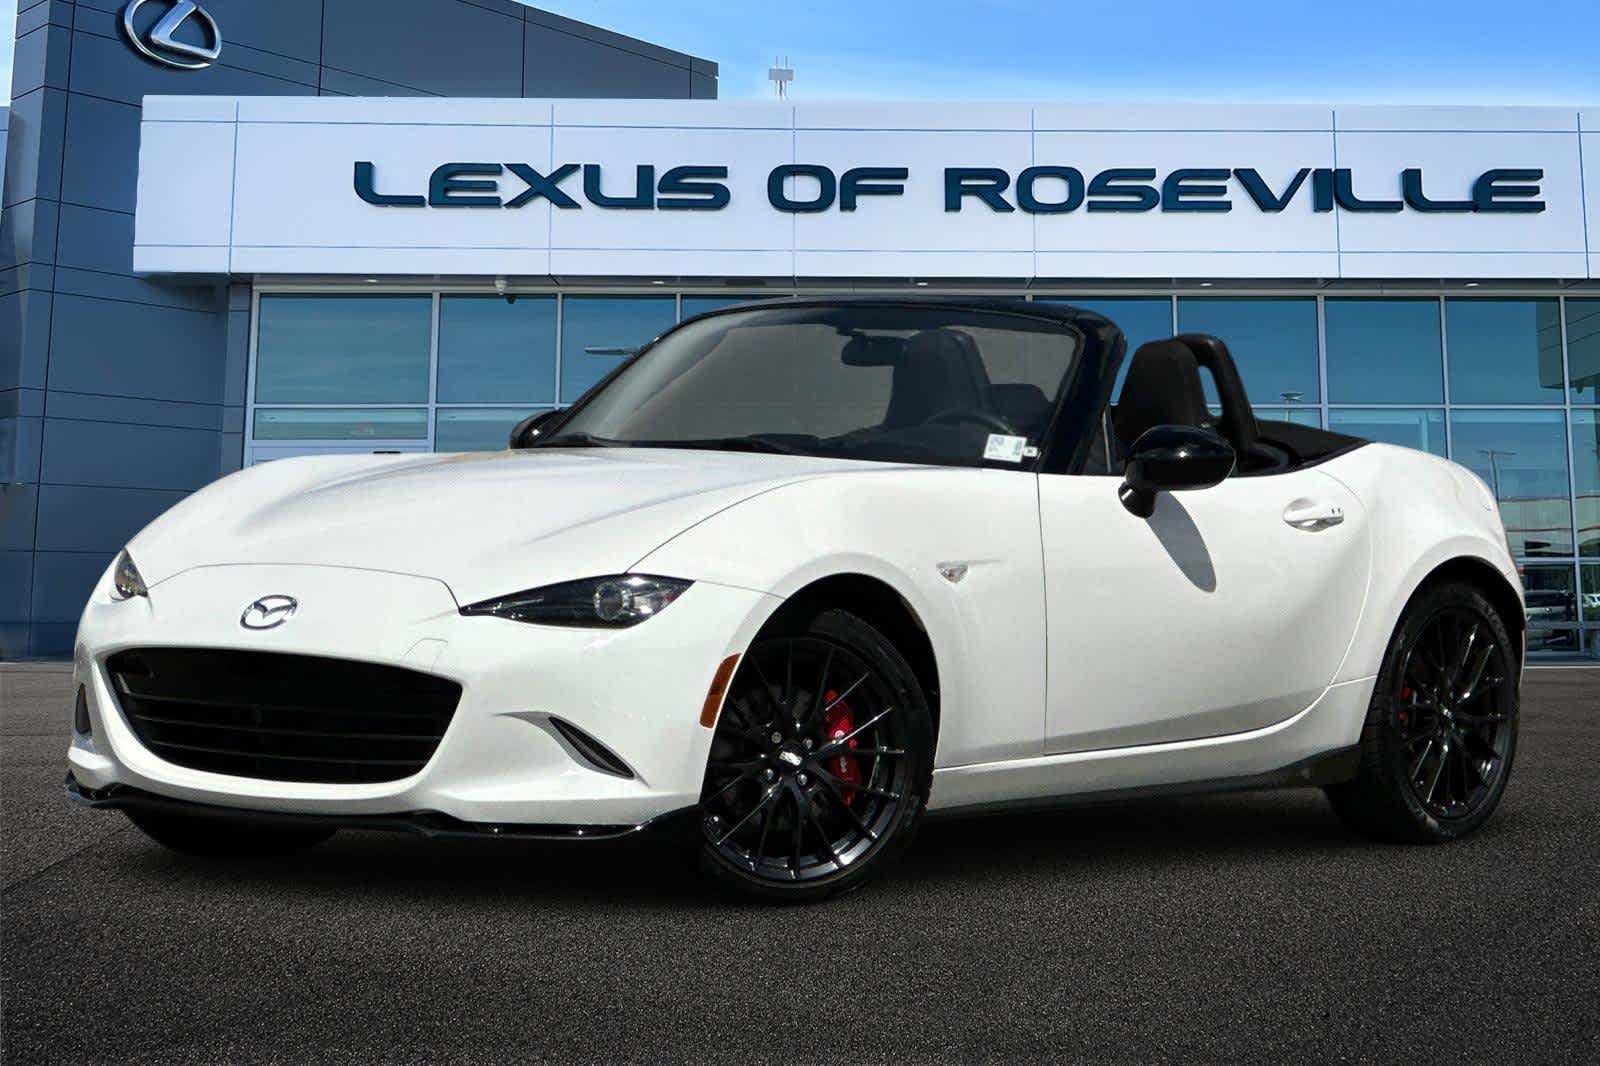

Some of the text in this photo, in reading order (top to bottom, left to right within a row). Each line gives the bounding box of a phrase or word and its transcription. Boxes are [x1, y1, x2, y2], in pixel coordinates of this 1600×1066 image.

[354, 161, 1546, 214] LEXUS OF ROSEVILLE
